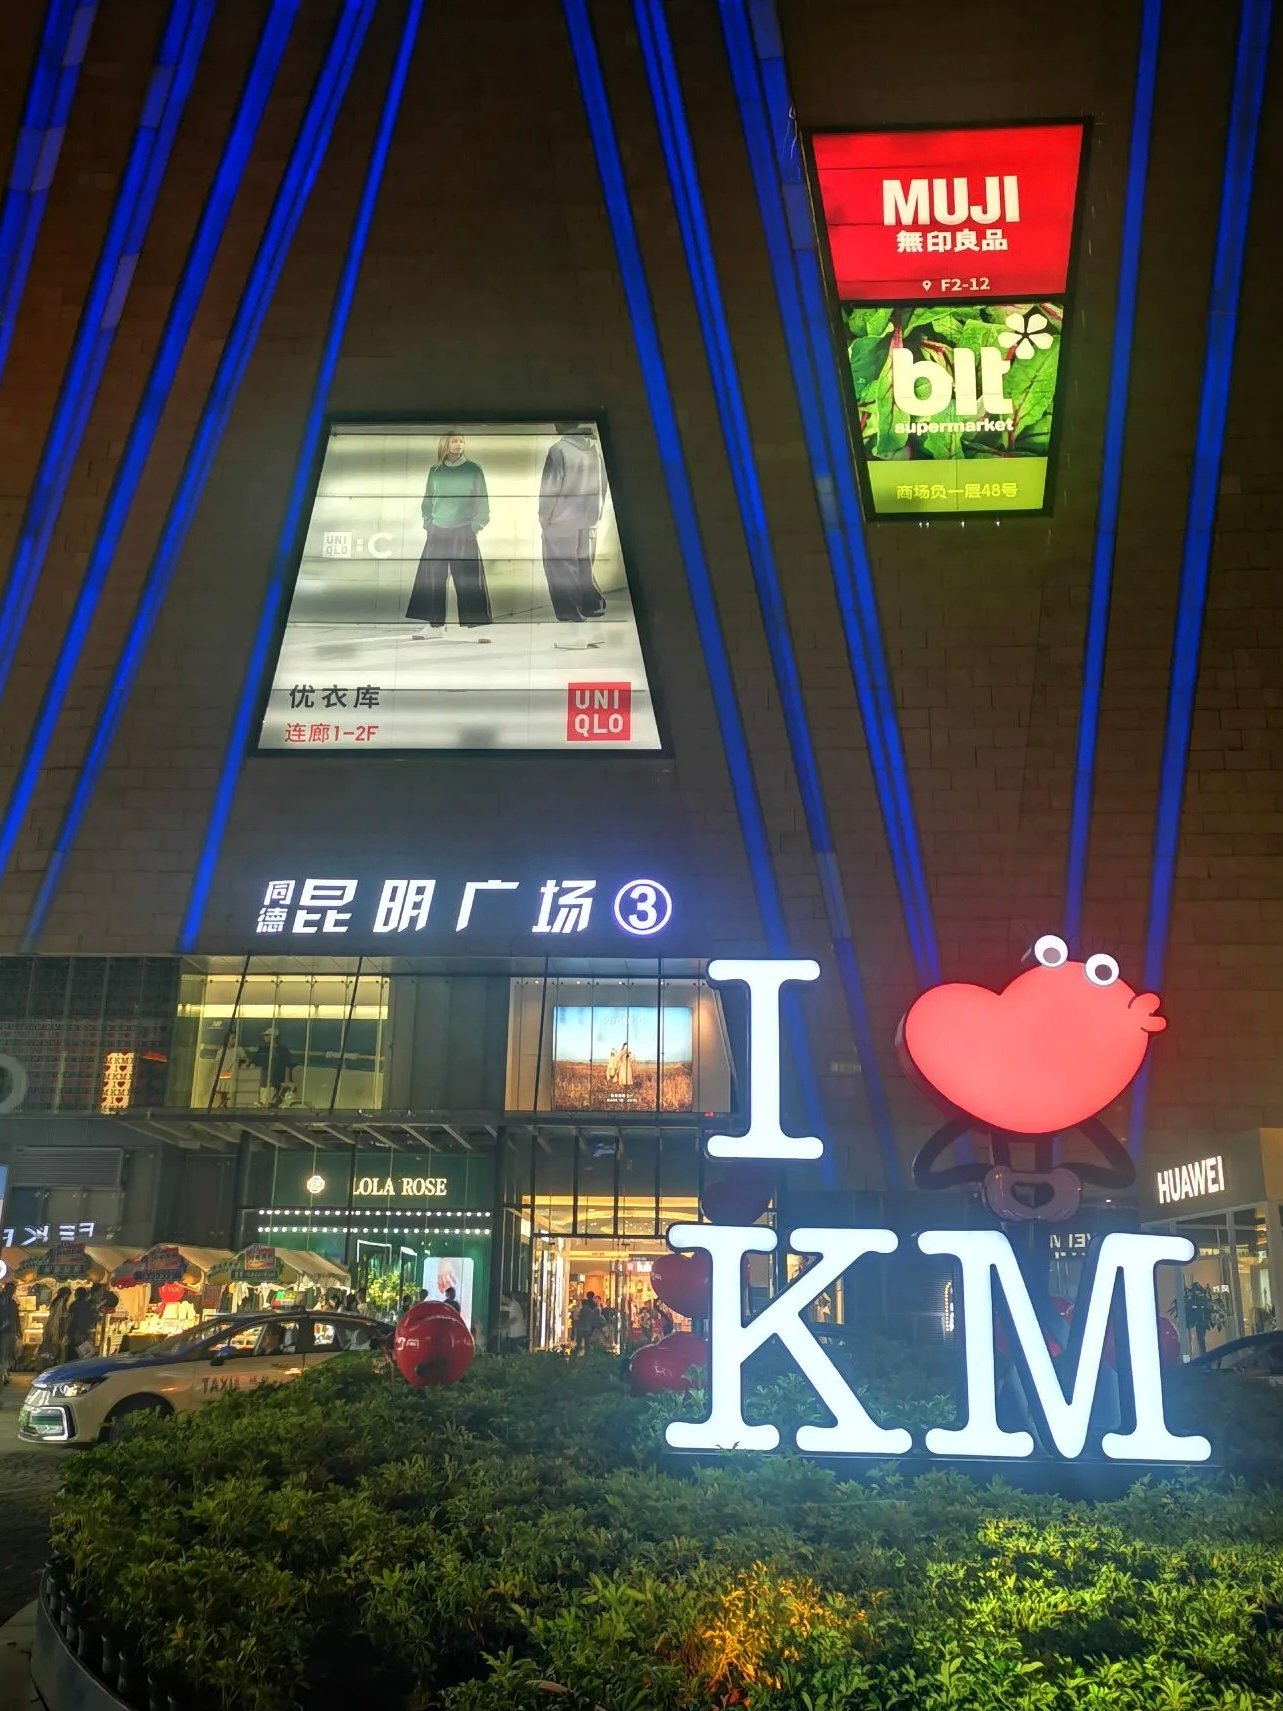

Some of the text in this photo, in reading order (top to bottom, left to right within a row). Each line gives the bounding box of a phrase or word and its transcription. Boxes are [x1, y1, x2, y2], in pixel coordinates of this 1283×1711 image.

[882, 175, 1020, 226] MUJI
[896, 229, 1008, 254] 無印良品
[940, 277, 991, 293] F2-12
[894, 417, 1015, 435] supermarket
[896, 483, 1019, 501] 商场负一层48号
[326, 535, 347, 545] UNI
[289, 683, 382, 709] 优衣库
[574, 689, 621, 710] UNI
[285, 722, 380, 744] 连廊1-2F
[573, 712, 624, 736] QLO
[706, 958, 824, 1160] I
[353, 1177, 448, 1196] LOLA ROSE
[1157, 1155, 1225, 1204] HUAWEI
